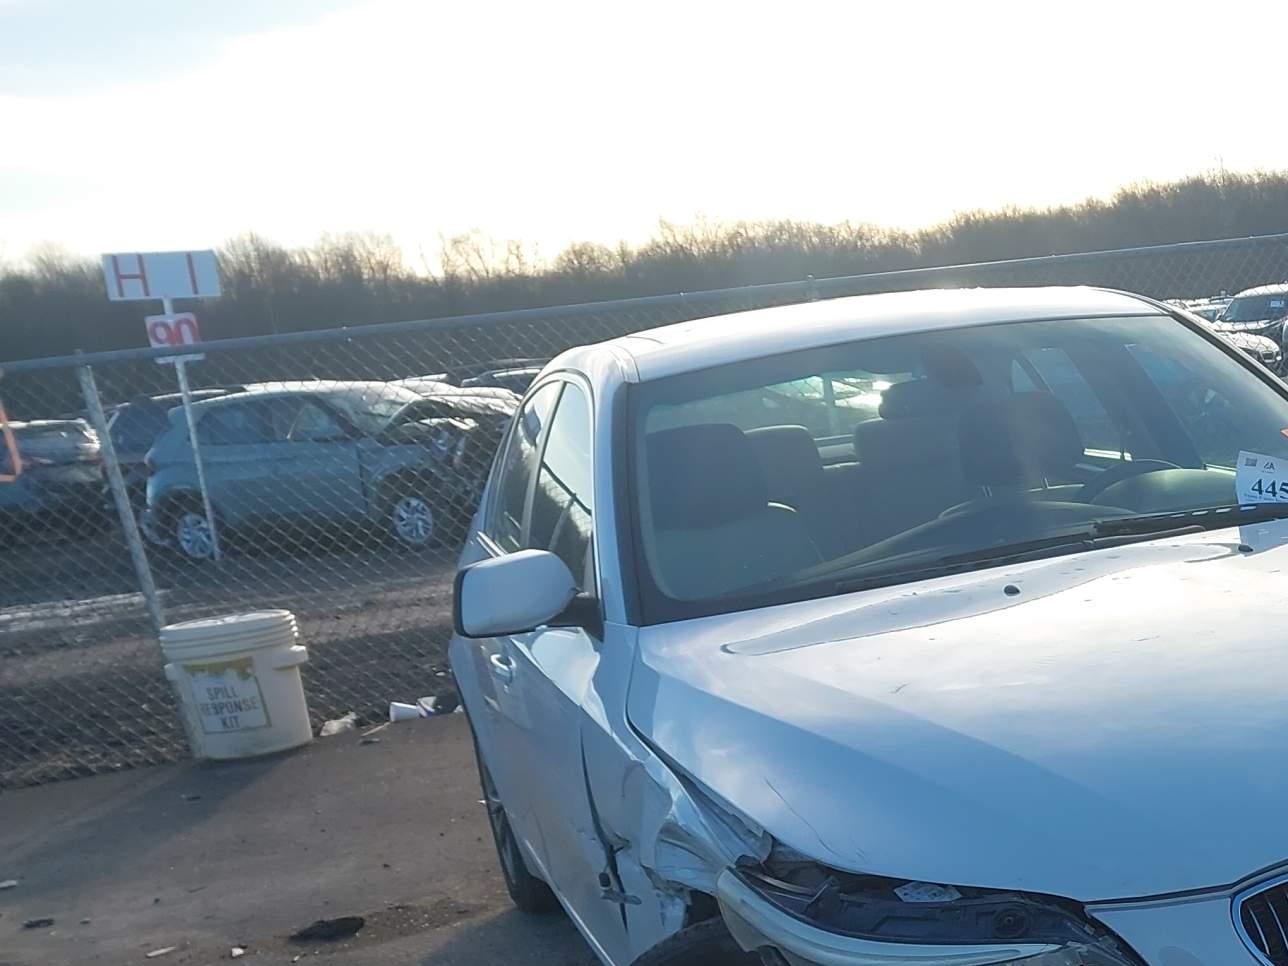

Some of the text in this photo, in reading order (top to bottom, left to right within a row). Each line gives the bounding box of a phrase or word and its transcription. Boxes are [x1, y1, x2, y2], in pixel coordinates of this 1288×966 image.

[112, 253, 150, 297] H
[206, 685, 239, 700] SPILL
[220, 715, 240, 729] KIT
